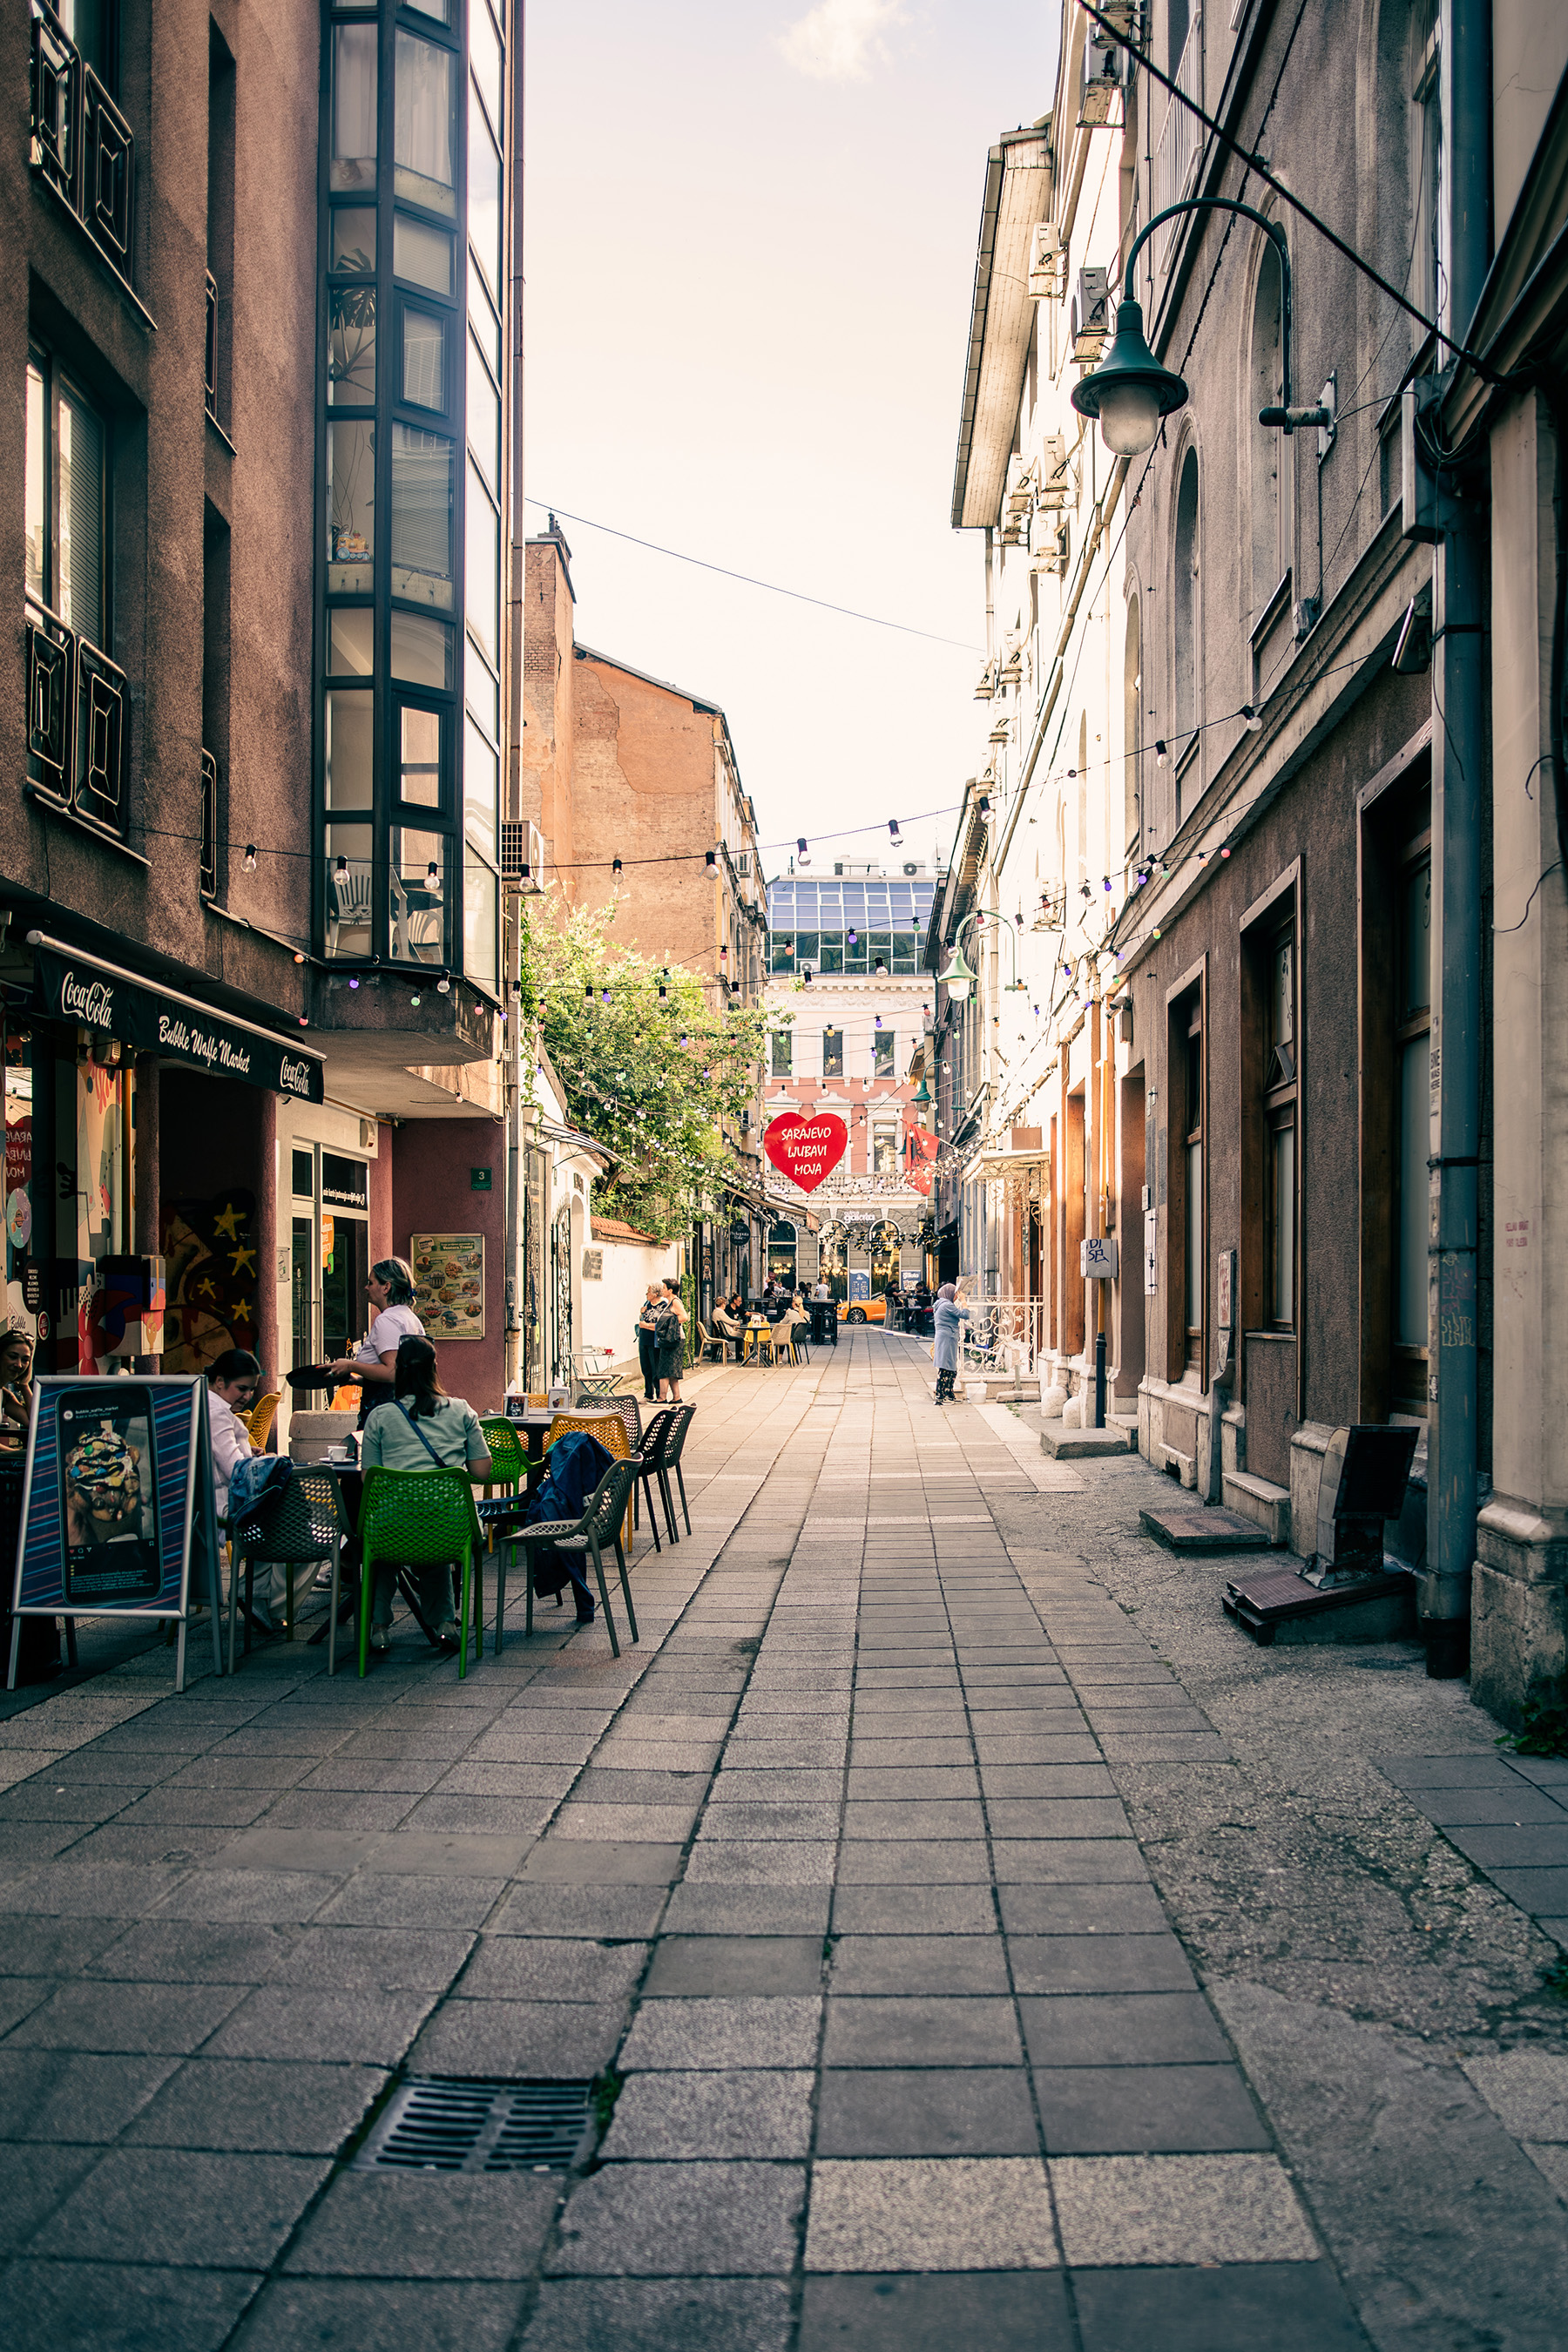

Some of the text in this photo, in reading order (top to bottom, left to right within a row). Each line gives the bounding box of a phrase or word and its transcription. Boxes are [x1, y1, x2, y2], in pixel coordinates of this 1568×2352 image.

[62, 971, 113, 1029] Coca-Cola
[159, 1015, 190, 1051] Bubble
[219, 1038, 250, 1073] Market
[280, 1056, 310, 1096] Coca-Cola
[781, 1126, 831, 1141] SARAJEVO
[787, 1145, 827, 1158] LJUBAVI
[478, 1171, 485, 1180] 3
[794, 1162, 821, 1175] MOJA
